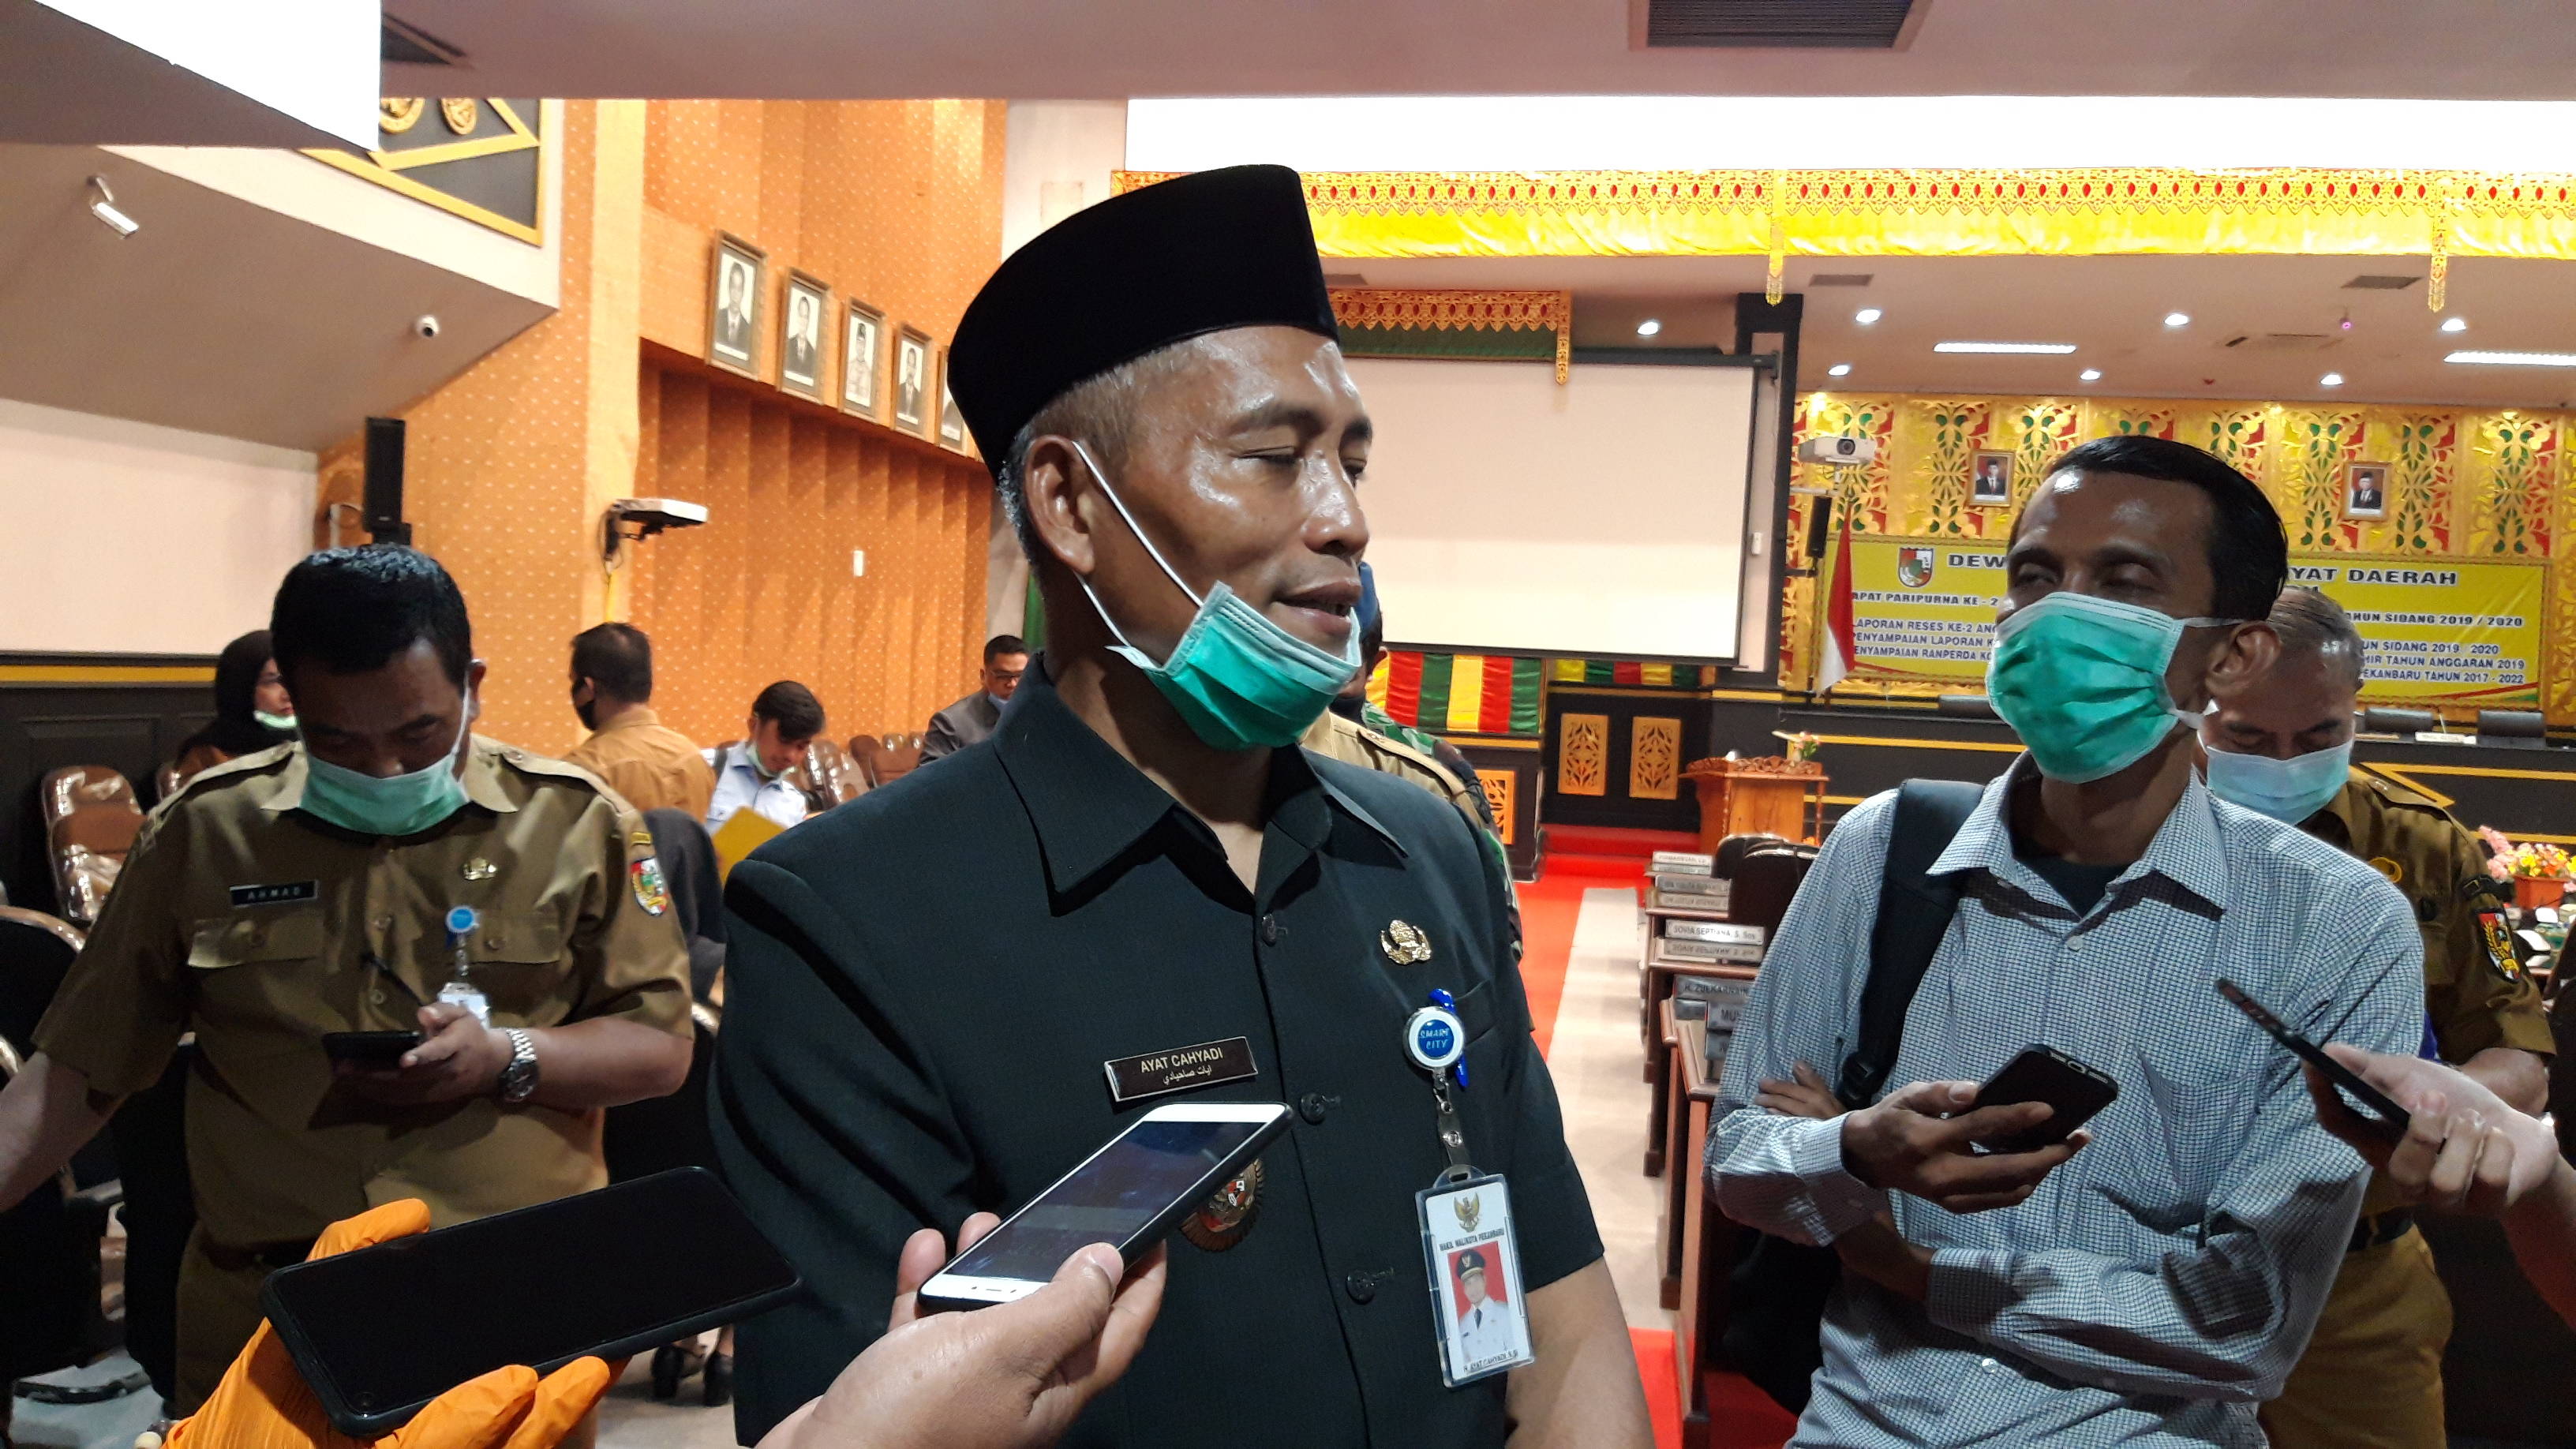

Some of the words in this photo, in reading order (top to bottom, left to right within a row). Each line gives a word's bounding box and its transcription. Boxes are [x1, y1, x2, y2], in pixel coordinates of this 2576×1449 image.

[2291, 567, 2337, 580] YAT
[2348, 569, 2457, 585] DAERAH
[1885, 593, 1958, 605] PARIPURNA
[1963, 596, 1978, 605] KE
[1990, 597, 1998, 606] 2
[2385, 613, 2435, 623] SIDANG
[2439, 615, 2473, 625] 2019
[2488, 617, 2523, 627] 2020
[1908, 620, 1943, 631] RESES
[1948, 622, 1972, 633] KE-2
[2383, 641, 2428, 652] SIDANG
[2432, 643, 2460, 653] 2019
[2471, 644, 2499, 654] 2020
[1931, 635, 1983, 646] LAPORAN
[2386, 655, 2425, 665] TAHUN
[2429, 657, 2494, 668] ANGGARAN
[2497, 660, 2525, 669] 2019
[1922, 649, 1976, 660] RANPERDA
[2424, 671, 2460, 681] TAHUN
[2464, 672, 2488, 682] 2017
[2499, 675, 2523, 683] 2022
[248, 886, 301, 900] AHMAD
[1420, 1028, 1449, 1038] SMART
[1426, 1039, 1449, 1049] CITY
[1141, 1057, 1168, 1073] AYAT
[1171, 1046, 1223, 1066] CAHYADI
